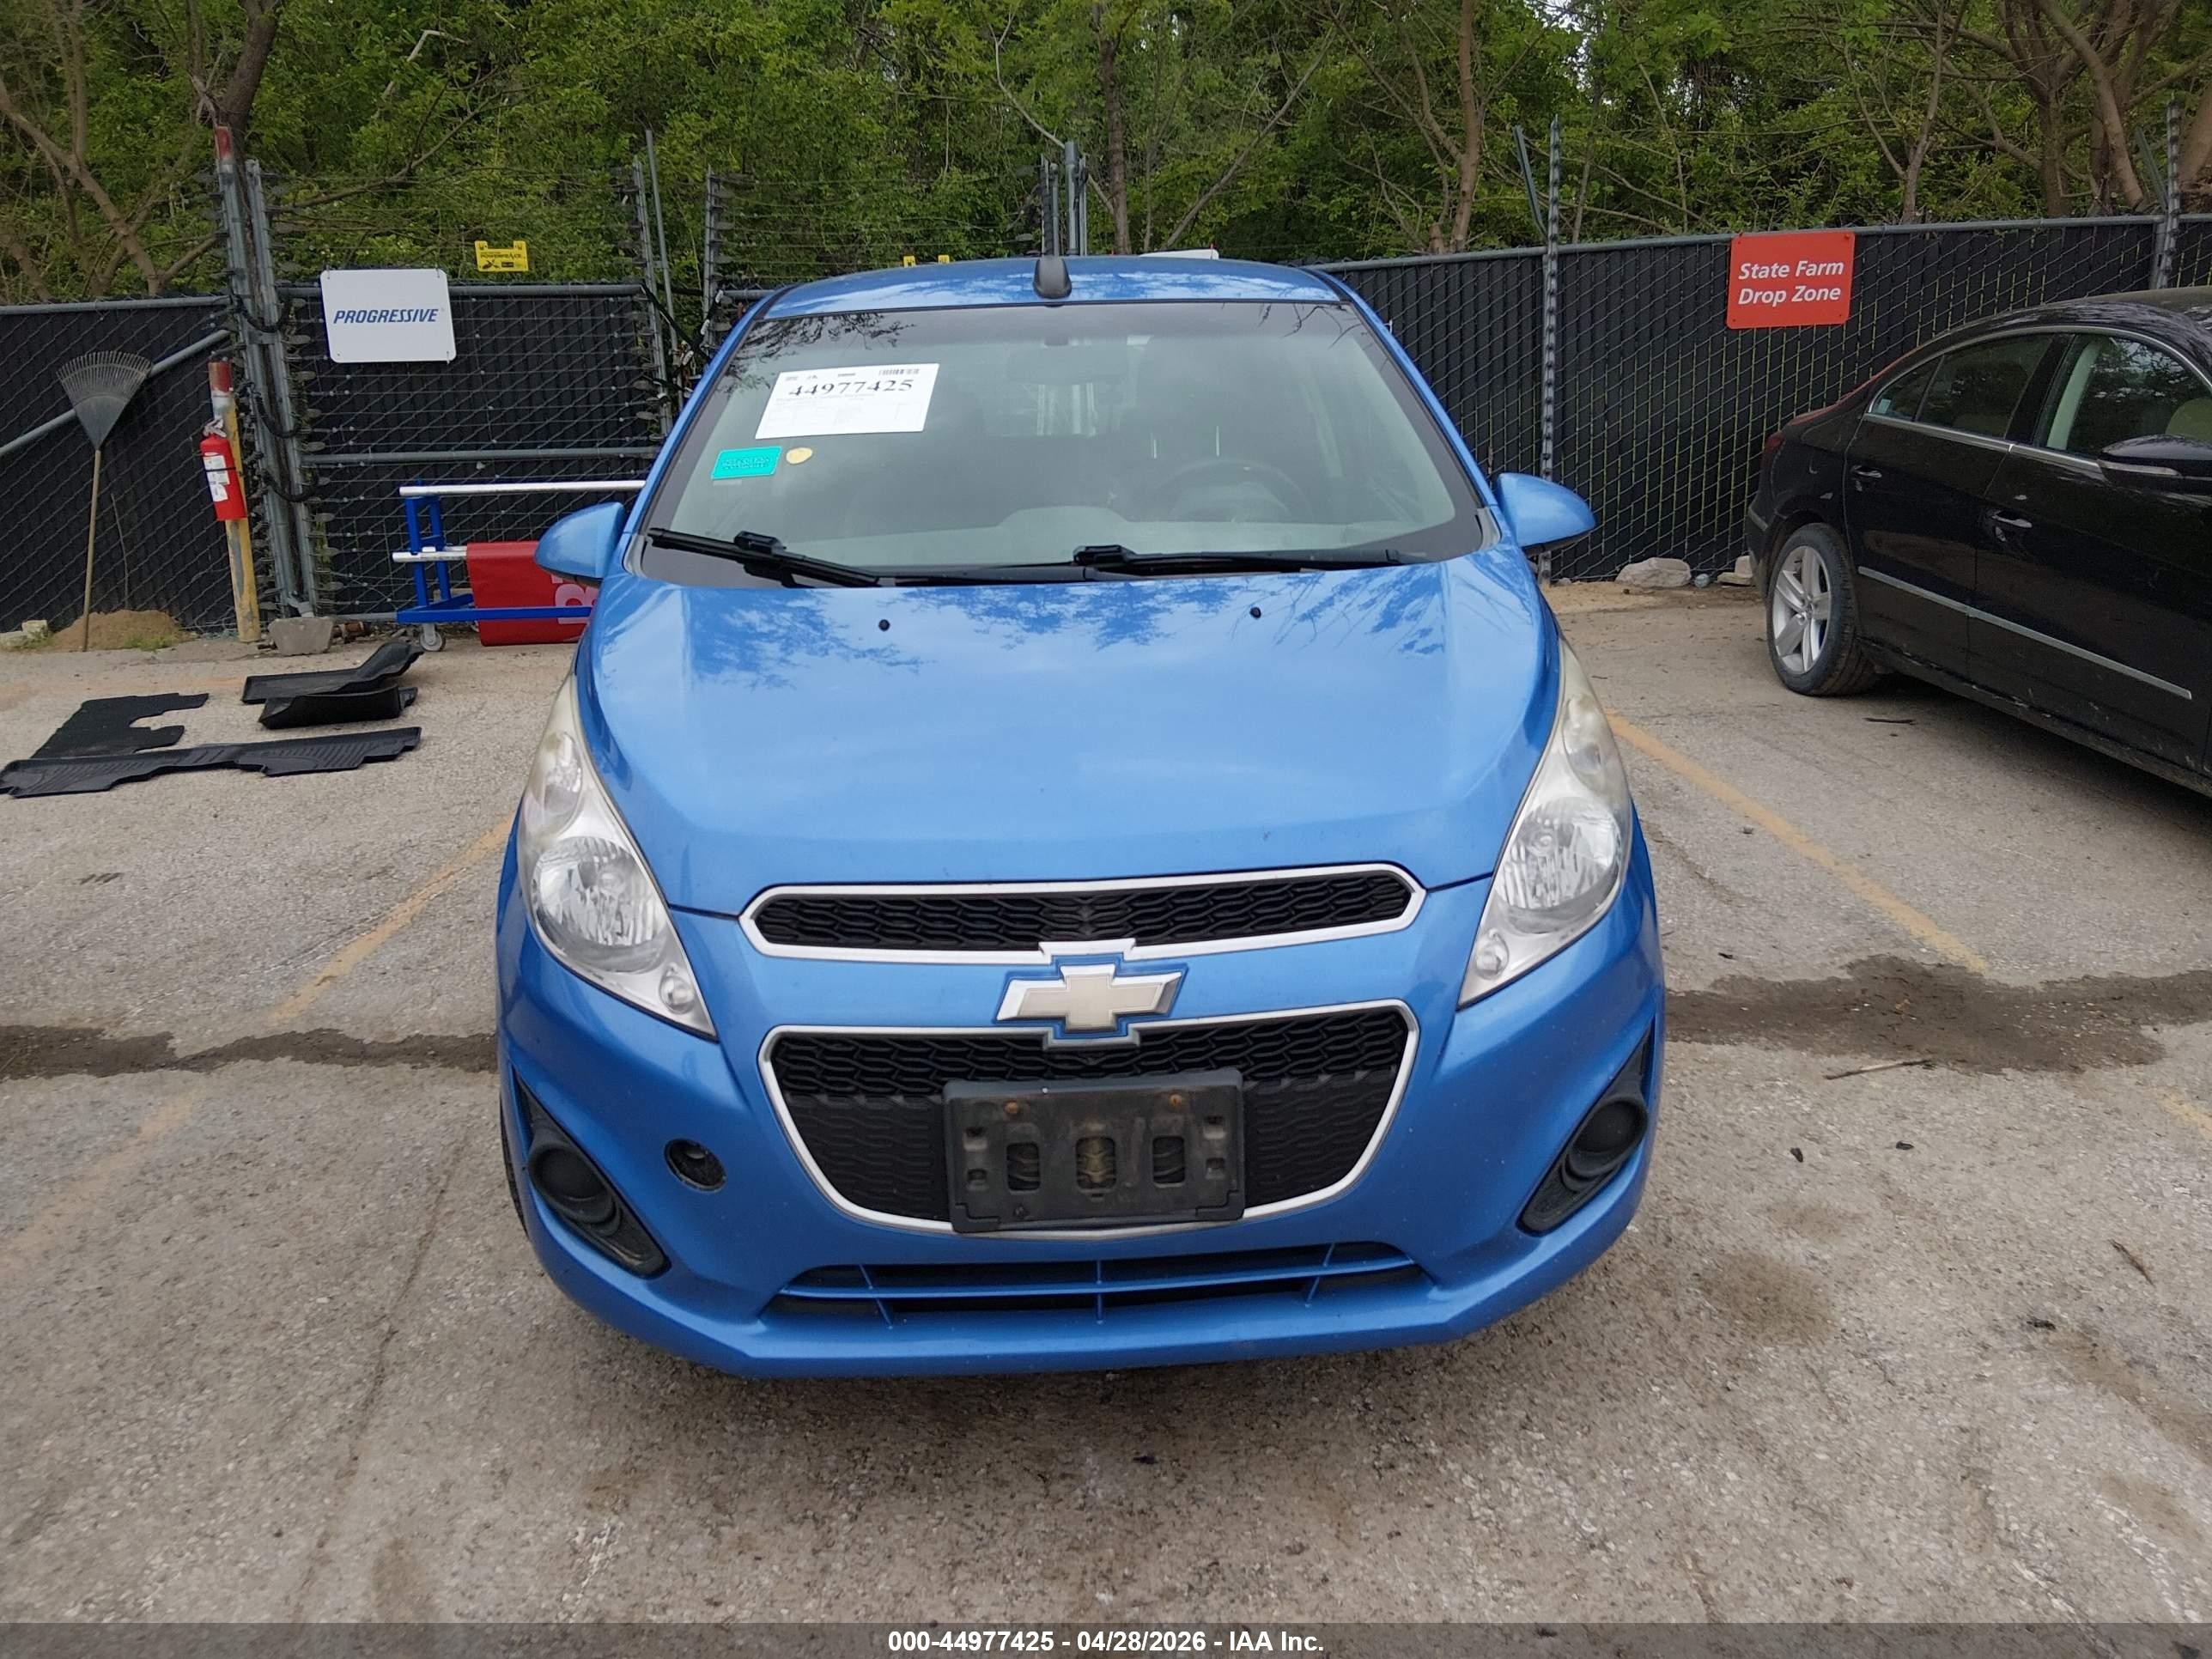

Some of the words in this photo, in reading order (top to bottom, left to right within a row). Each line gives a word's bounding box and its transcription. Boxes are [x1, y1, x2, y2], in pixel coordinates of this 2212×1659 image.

[1738, 262, 1790, 280] State
[1795, 260, 1844, 277] Farm
[1738, 288, 1787, 307] Drop
[1791, 285, 1842, 302] Zone
[333, 308, 439, 324] PROGRESSIVE
[788, 379, 915, 397] 44977425
